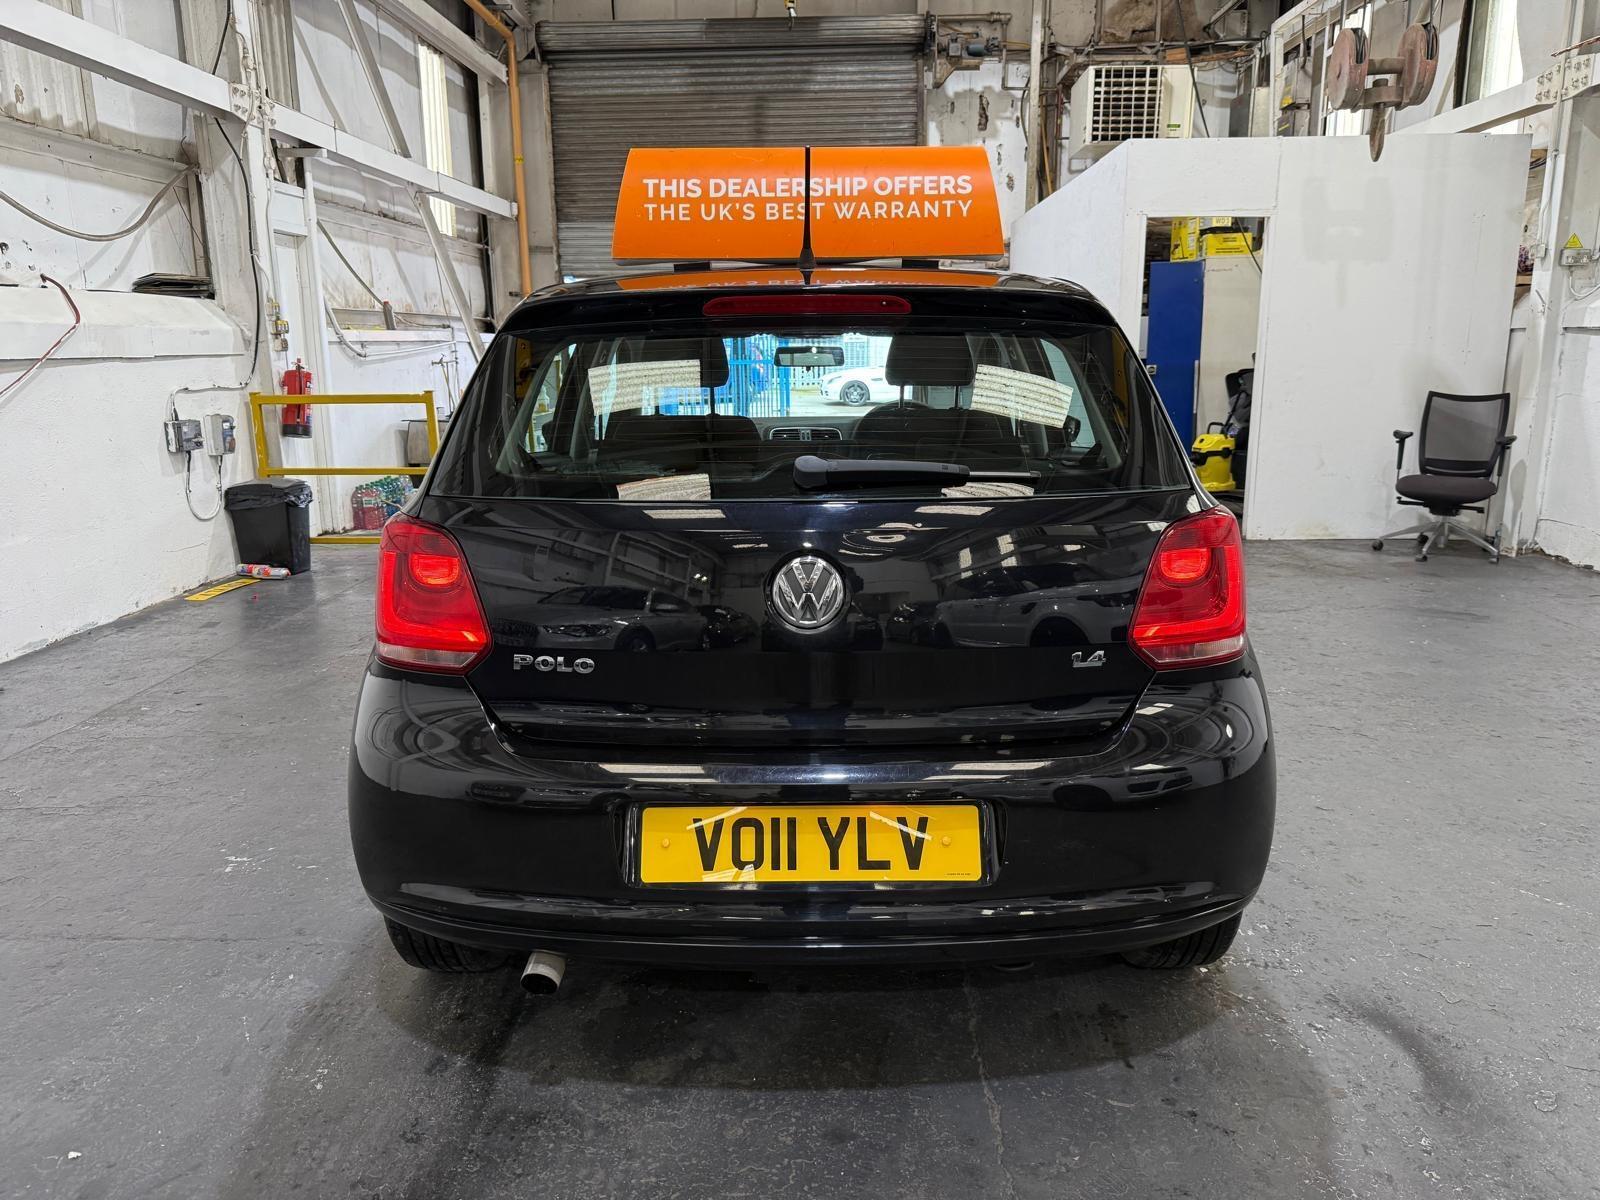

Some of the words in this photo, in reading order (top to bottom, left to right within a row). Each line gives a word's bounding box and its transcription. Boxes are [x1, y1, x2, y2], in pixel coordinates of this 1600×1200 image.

[643, 178, 702, 199] THIS
[709, 177, 868, 198] DEALERSHIP
[873, 175, 973, 195] OFFERS
[643, 203, 691, 221] THE
[700, 202, 756, 221] UK'S
[766, 202, 826, 221] BEST
[833, 199, 973, 220] WARRANTY
[513, 653, 595, 674] POLO
[693, 817, 797, 871] VO11
[817, 816, 929, 871] YLV
